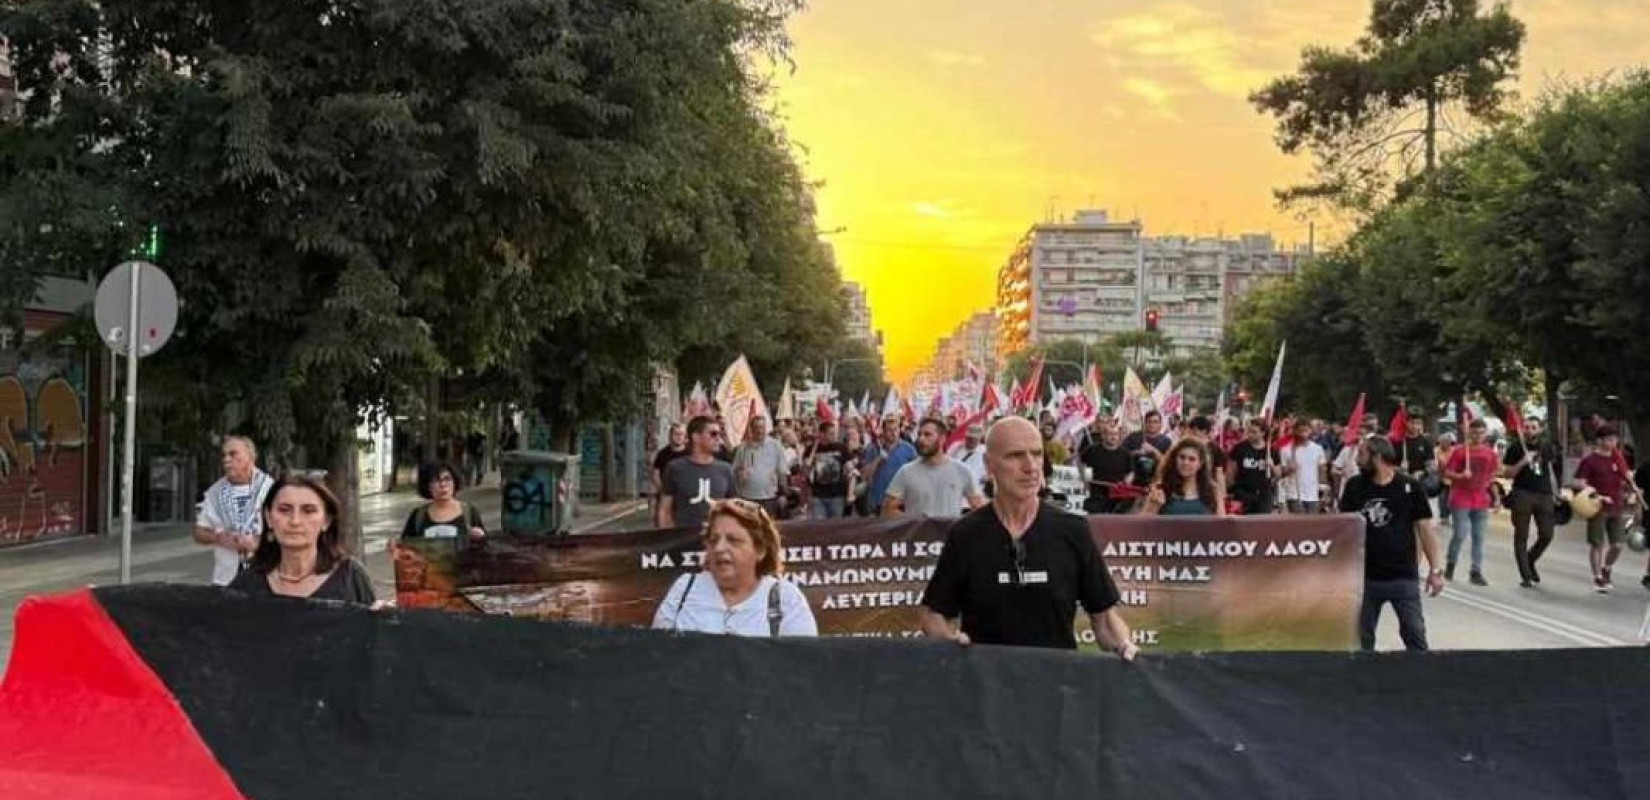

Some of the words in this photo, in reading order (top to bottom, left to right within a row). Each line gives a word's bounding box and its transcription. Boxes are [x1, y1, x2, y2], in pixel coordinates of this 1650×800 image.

[641, 552, 675, 569] ΝΑ
[827, 543, 886, 561] ΤΩΡΑ
[891, 541, 907, 557] Η
[1102, 541, 1257, 557] ΑΙΣΤΙΝΙΑΚΟΥ
[1265, 540, 1332, 556] ΛΑΟΥ
[1159, 565, 1212, 581] ΜΑΣ
